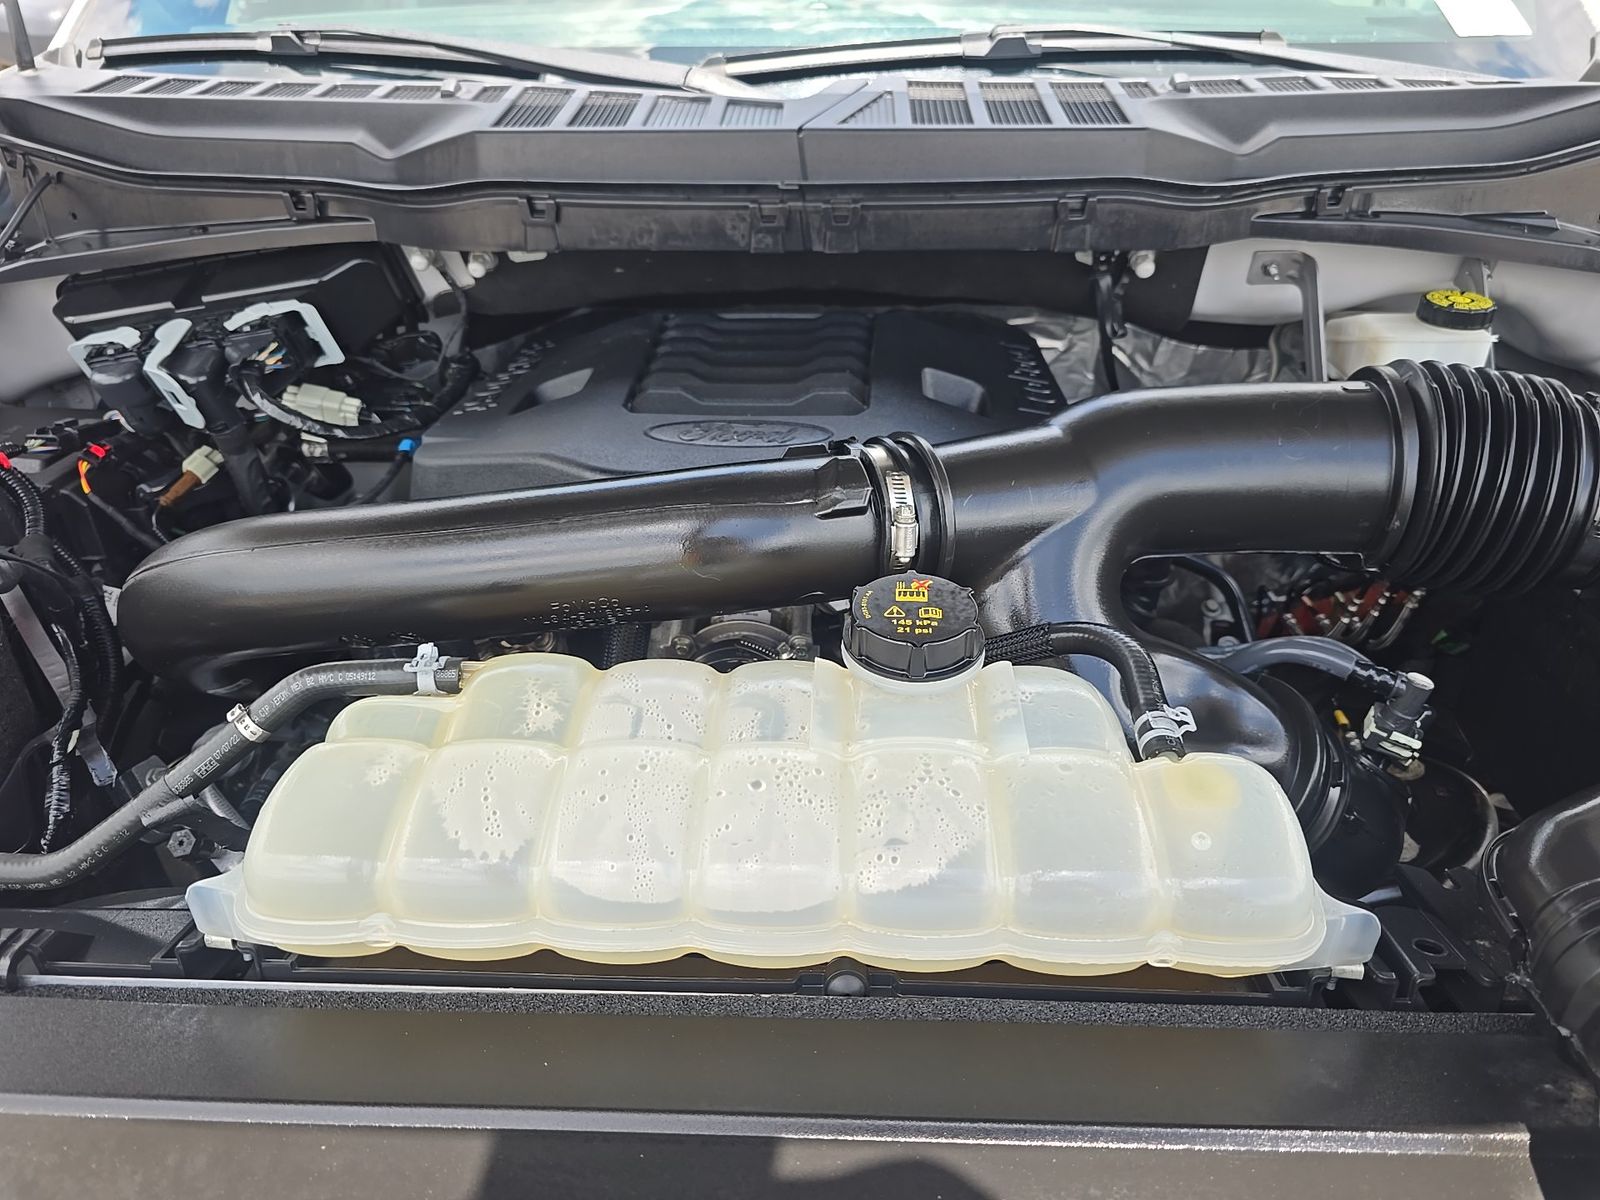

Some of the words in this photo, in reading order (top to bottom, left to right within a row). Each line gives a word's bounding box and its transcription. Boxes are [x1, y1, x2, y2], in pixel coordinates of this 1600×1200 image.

[679, 422, 800, 444] Ford
[891, 618, 913, 626] 145
[915, 619, 939, 627] kPa
[914, 627, 933, 635] psi
[214, 733, 241, 761] 07/07/22
